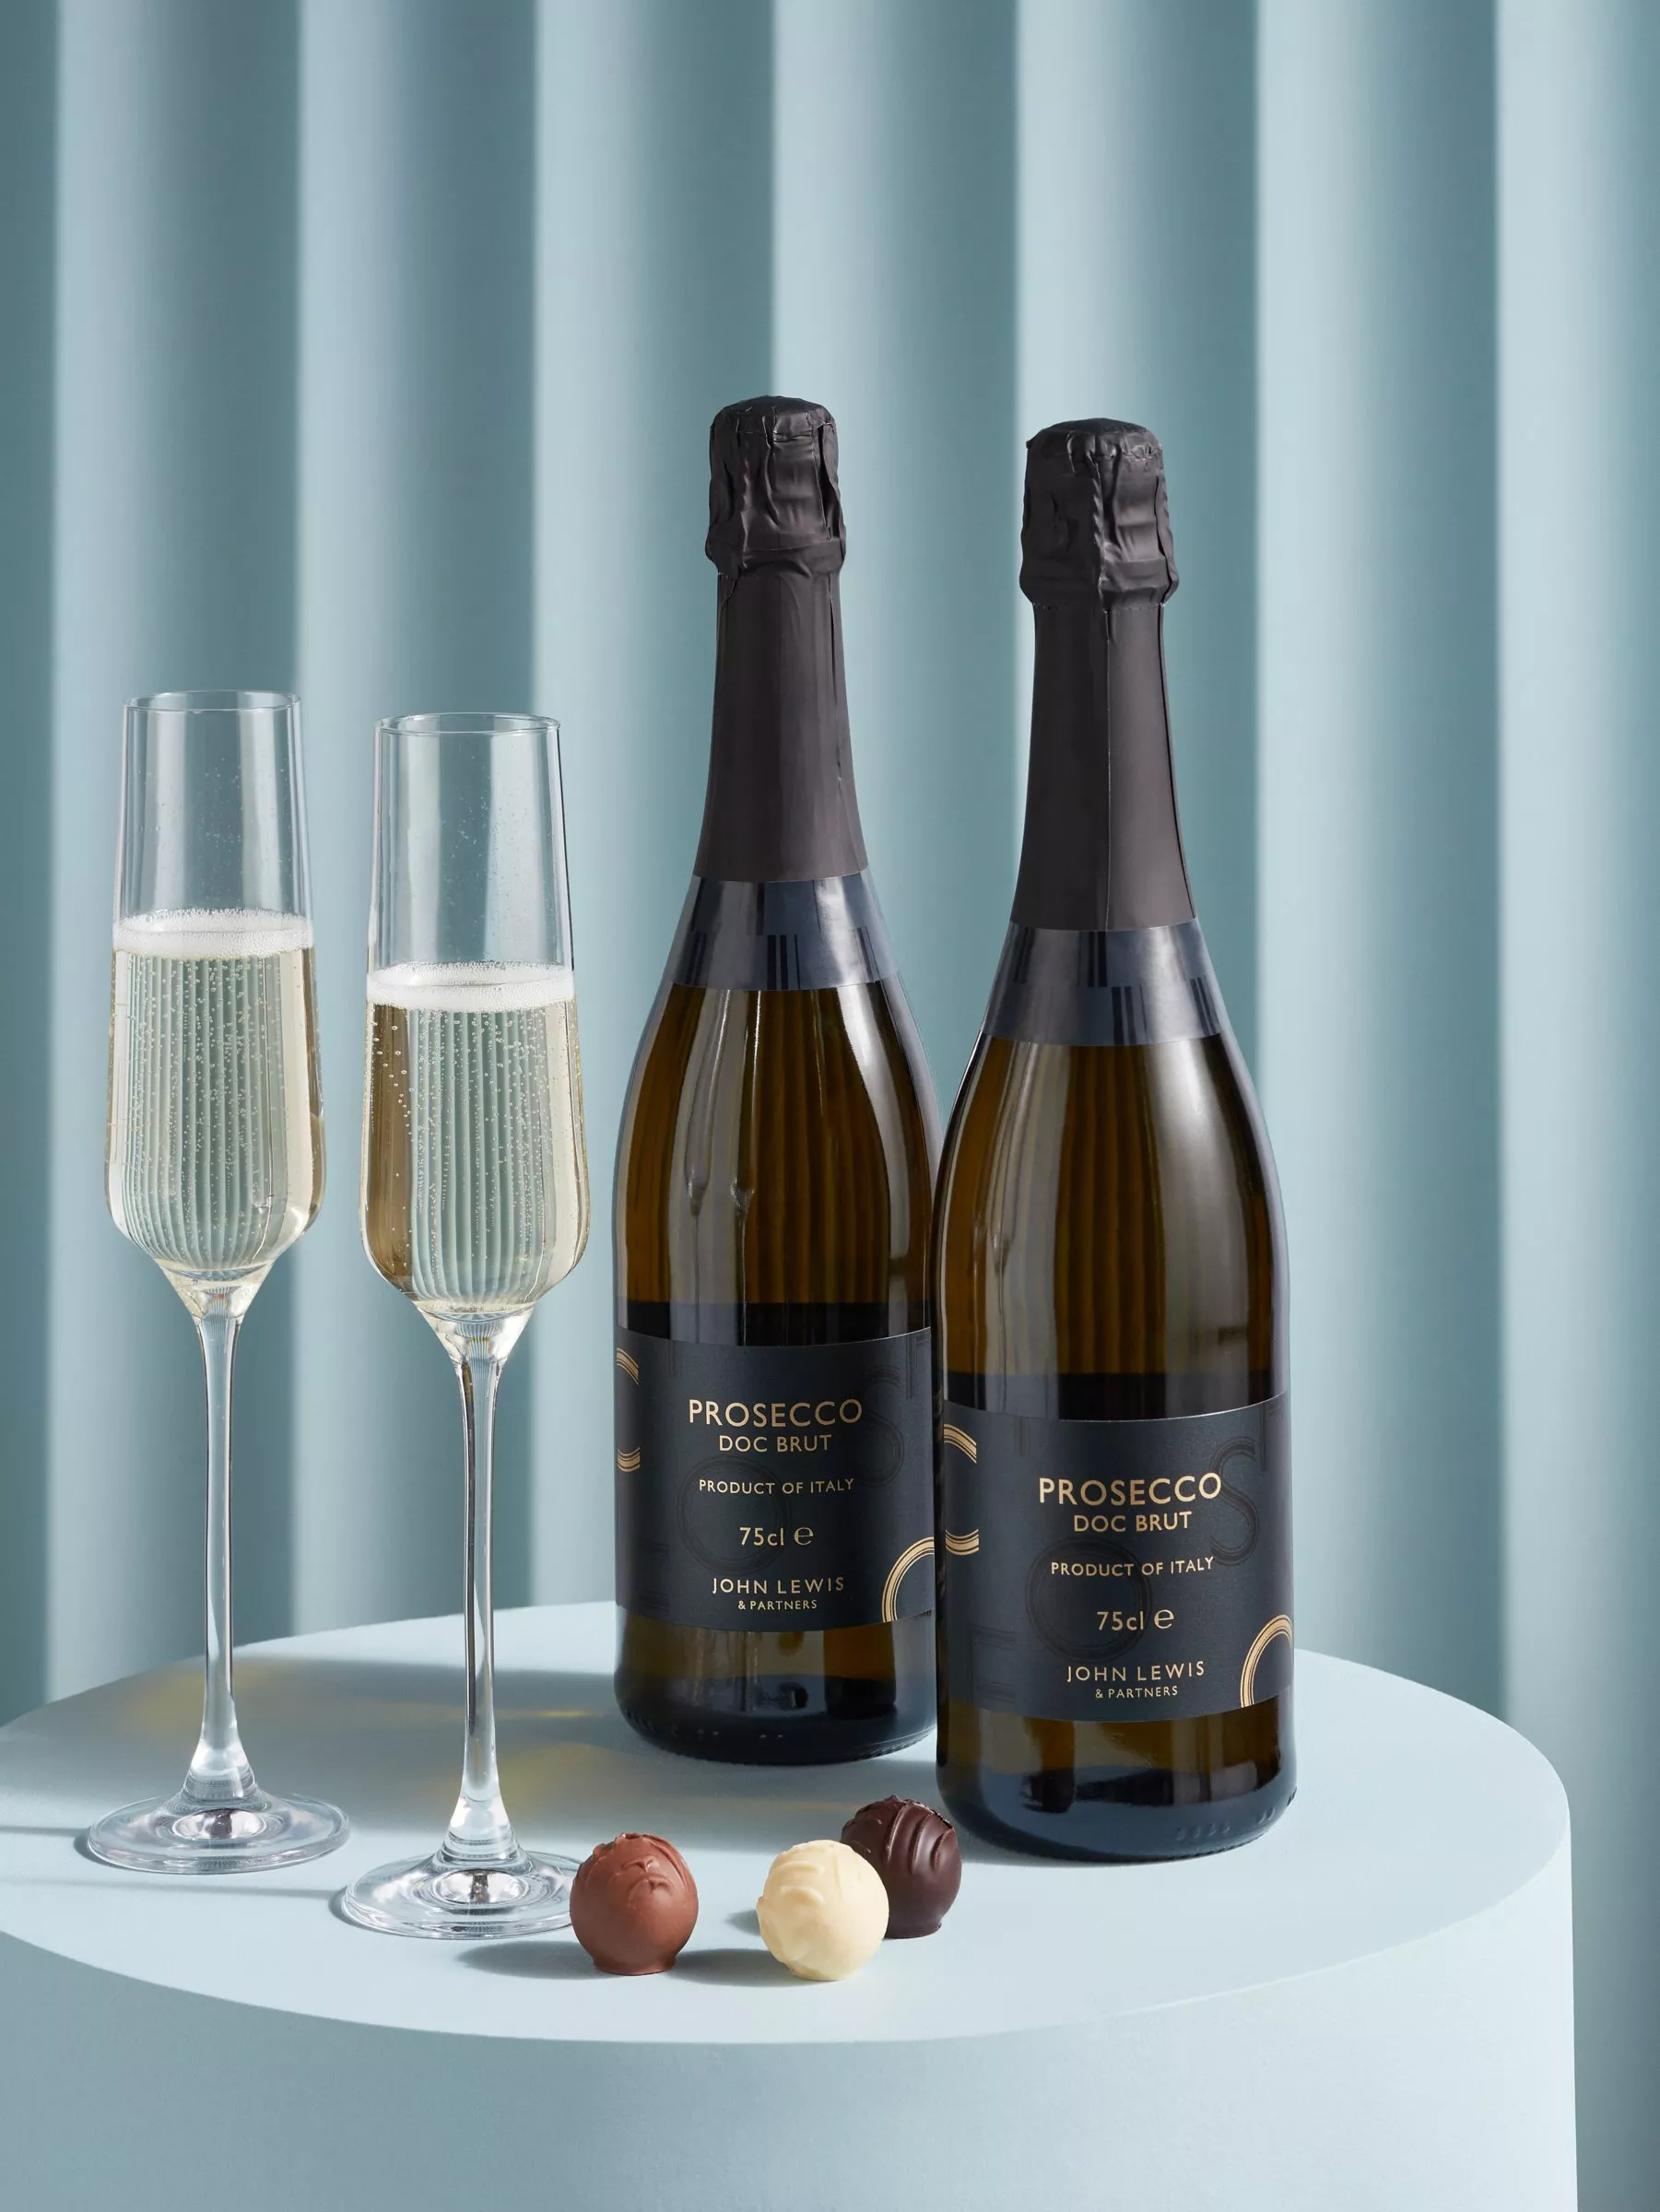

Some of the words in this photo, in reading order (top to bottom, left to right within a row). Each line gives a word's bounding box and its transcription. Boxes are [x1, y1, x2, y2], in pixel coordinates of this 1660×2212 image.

[689, 1399, 863, 1427] PROSECCO
[719, 1435, 767, 1453] DOC
[777, 1435, 831, 1453] BRUT
[699, 1479, 775, 1495] PRODUCT
[783, 1481, 804, 1494] OF
[810, 1478, 854, 1493] ITALY
[1039, 1473, 1222, 1505] PROSECCO
[1074, 1515, 1125, 1532] DOC
[1136, 1512, 1192, 1531] BRUT
[739, 1526, 784, 1546] 75cl
[1051, 1562, 1134, 1577] PRODUCT
[1141, 1562, 1163, 1576] OF
[1171, 1556, 1215, 1574] ITALY
[712, 1577, 767, 1594] JOHN
[777, 1577, 844, 1594] LEWIS
[738, 1600, 746, 1610] &
[750, 1599, 818, 1611] PARTNERS
[1097, 1611, 1144, 1631] 75cl
[1066, 1666, 1126, 1683] JOHN
[1137, 1661, 1205, 1681] LEWIS
[1095, 1688, 1103, 1699] &
[1108, 1686, 1178, 1699] PARTNERS
